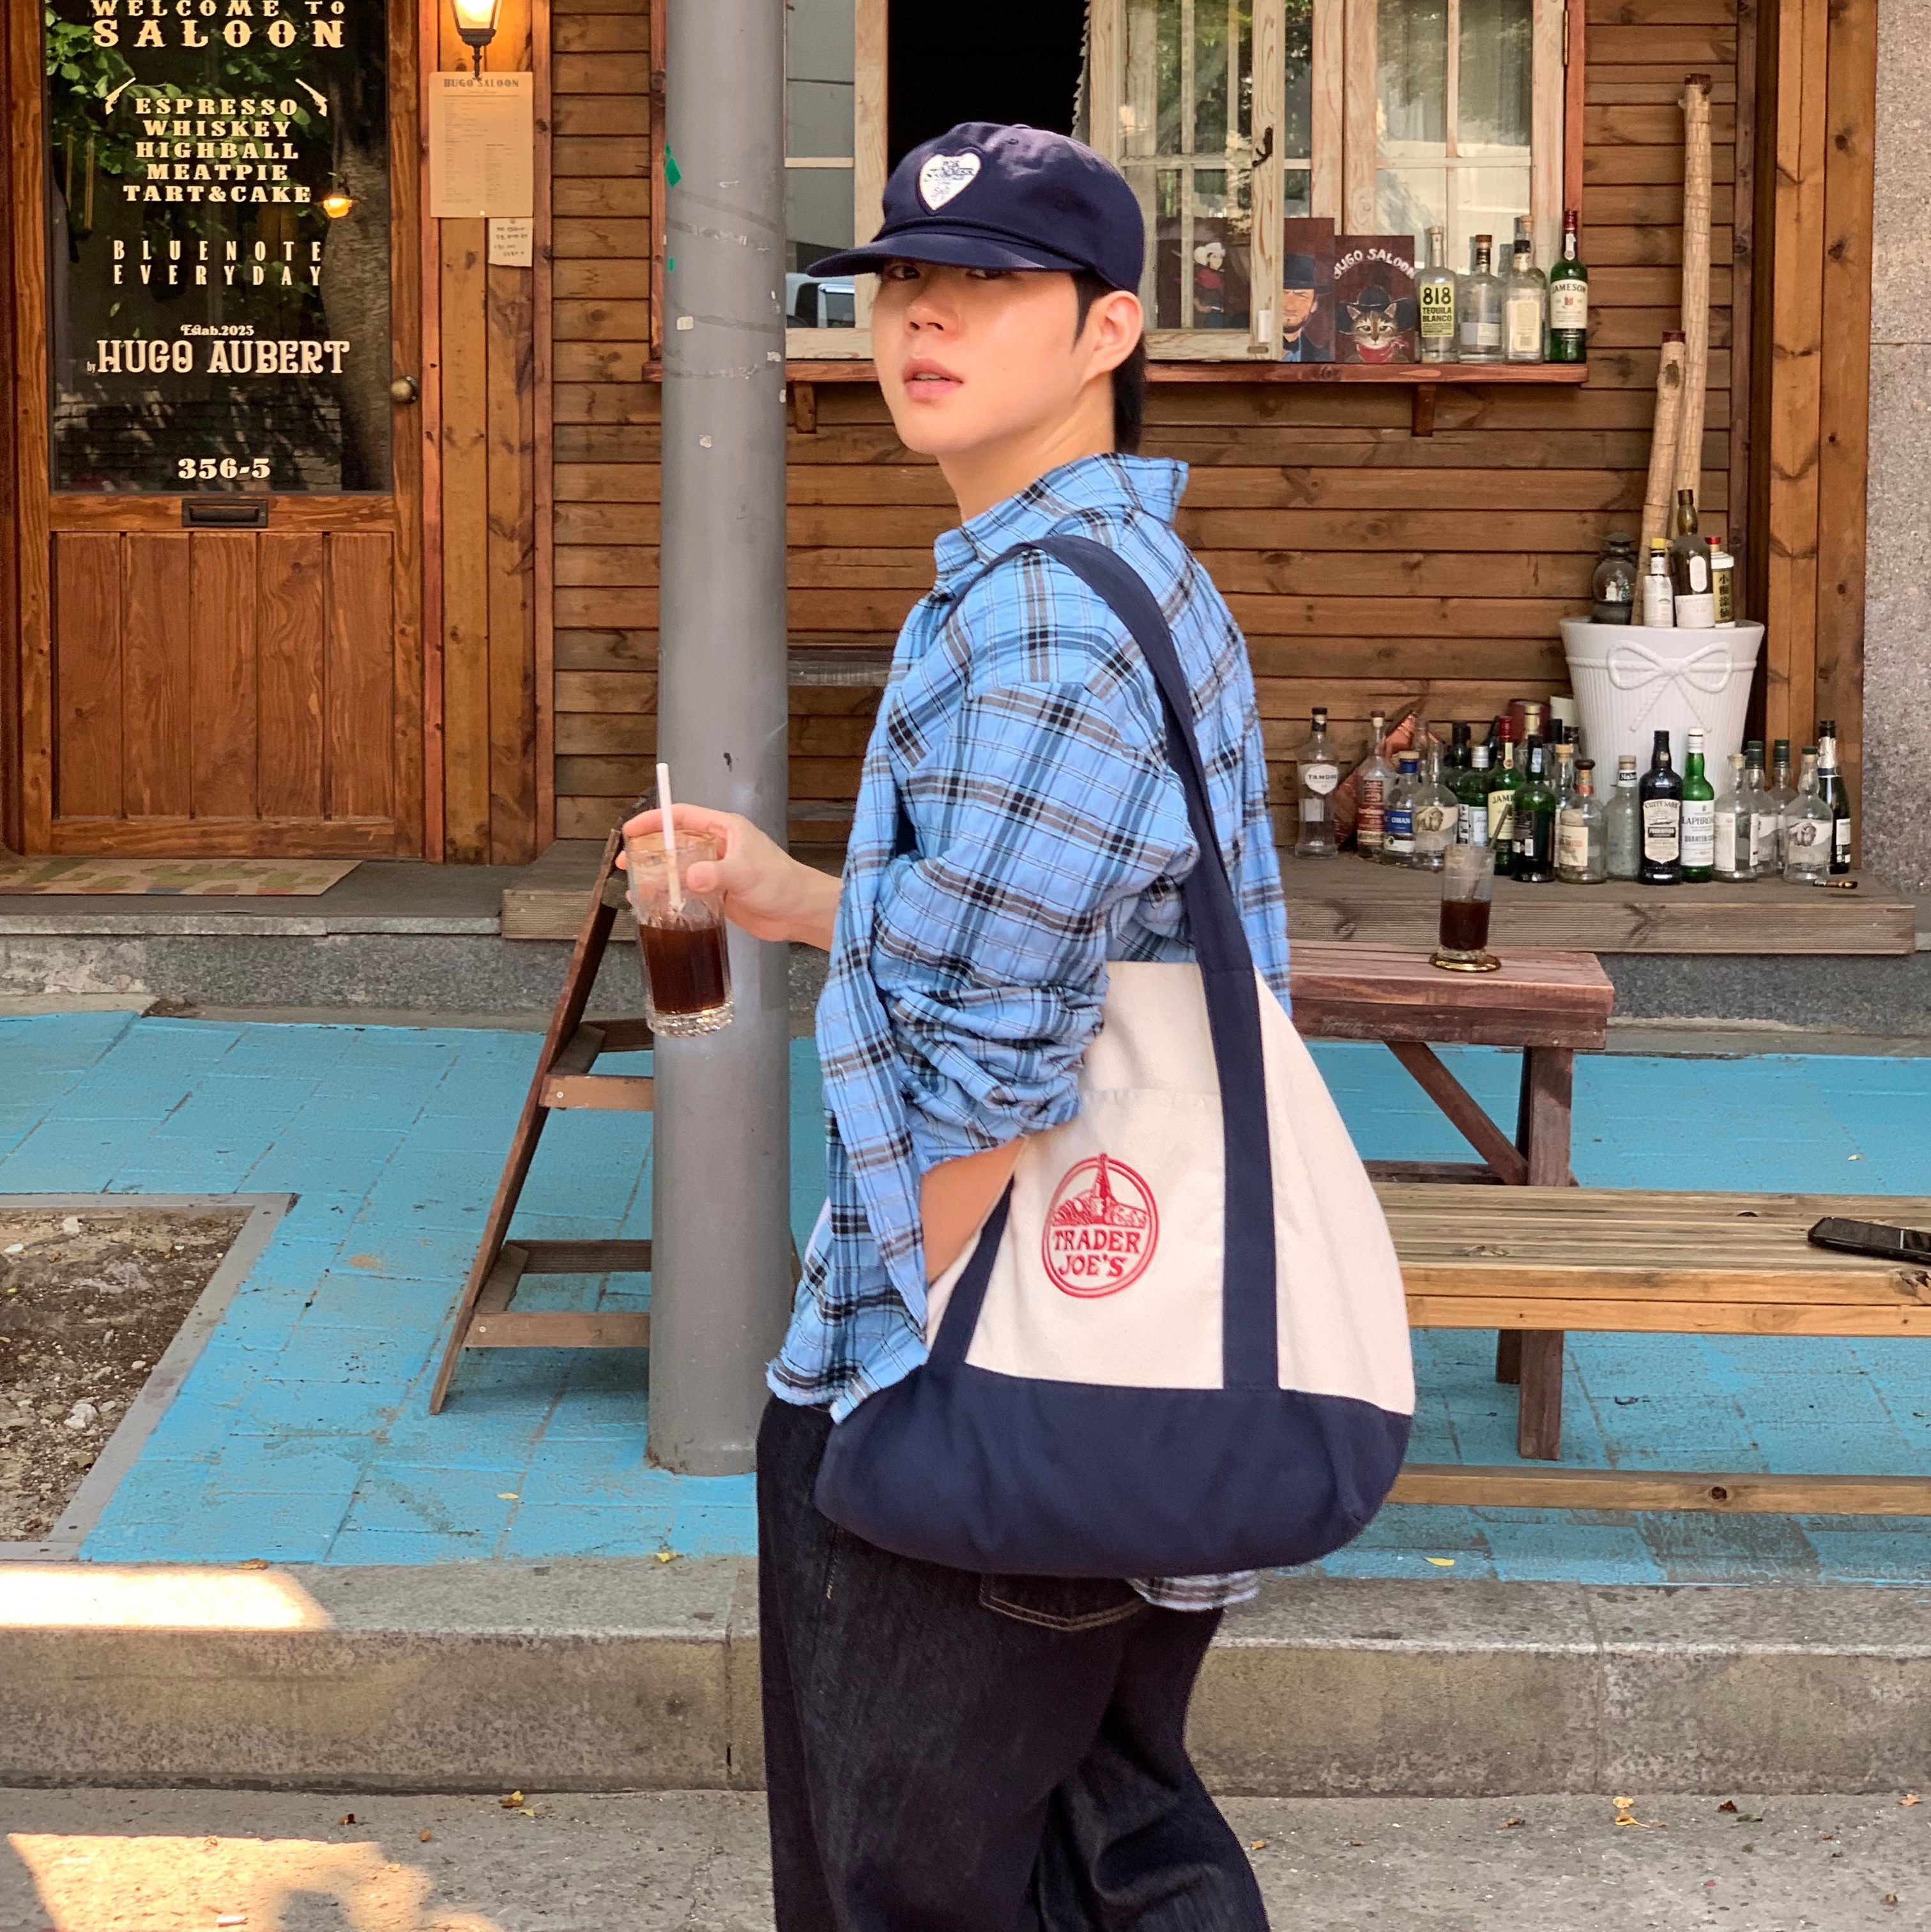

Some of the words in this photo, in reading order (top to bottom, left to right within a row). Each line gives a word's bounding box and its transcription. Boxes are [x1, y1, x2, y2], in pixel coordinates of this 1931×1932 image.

[91, 0, 279, 17] WELCOME
[305, 1, 345, 15] TO
[92, 19, 345, 49] SALOON
[444, 79, 473, 88] HUGO
[477, 79, 519, 88] SALOON
[135, 98, 298, 116] ESPRESSO
[142, 119, 291, 137] WHISKEY
[135, 141, 299, 160] HIGHBALL
[147, 164, 288, 181] MEATPIE
[123, 185, 311, 203] TART&CAKE
[114, 264, 321, 286] EVERYDAY
[1423, 287, 1451, 305] 818
[86, 361, 96, 374] by
[96, 340, 194, 374] HUGO
[206, 340, 350, 374] AUBERT
[178, 457, 271, 479] 356-5
[1055, 1229, 1141, 1254] TRADER
[1057, 1254, 1128, 1278] JOE'S
